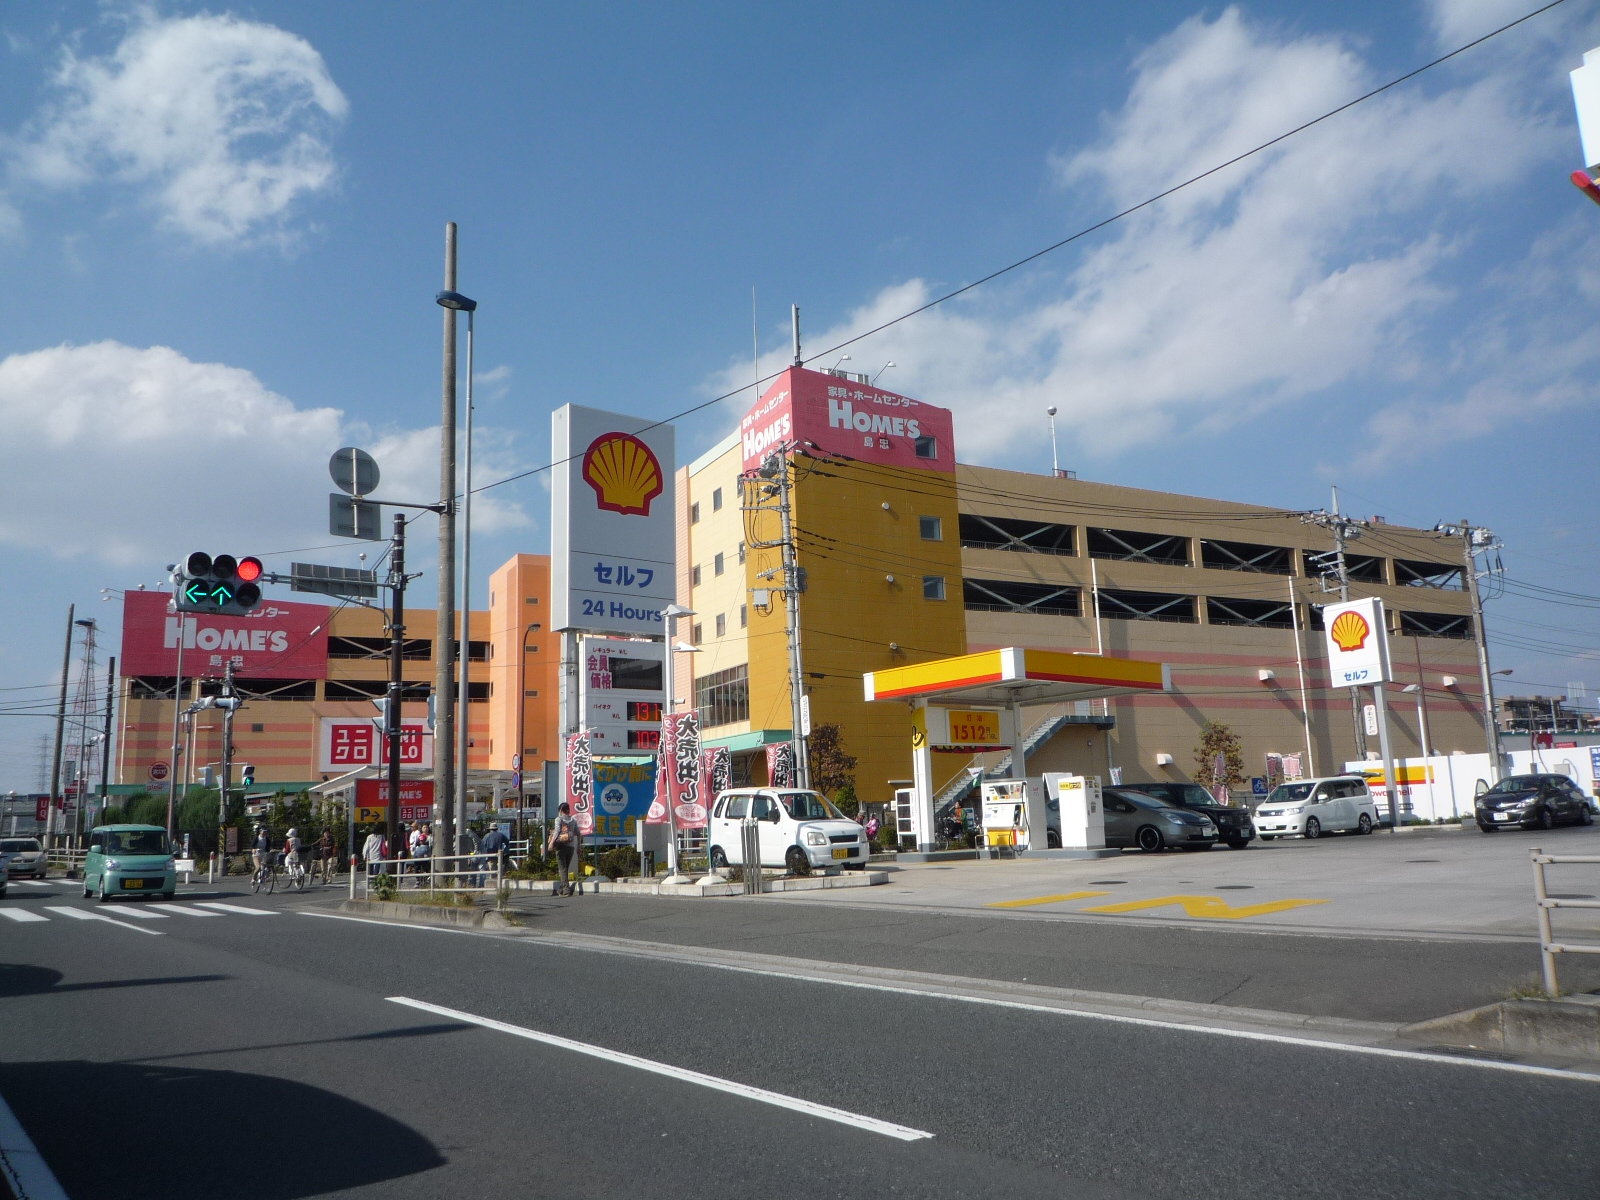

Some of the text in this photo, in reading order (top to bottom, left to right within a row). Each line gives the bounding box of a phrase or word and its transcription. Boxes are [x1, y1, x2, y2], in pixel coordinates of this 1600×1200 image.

[827, 386, 919, 407] 家具・ホームセンター
[828, 399, 921, 439] HOME'S
[743, 413, 790, 461] HOME'S
[593, 562, 654, 588] セルフ
[582, 599, 663, 622] 24 Hours
[164, 616, 289, 652] HOME'S
[588, 654, 608, 671] 会員
[591, 672, 612, 689] 価格
[1344, 670, 1368, 681] セルフ
[337, 729, 367, 742] ユニ
[953, 725, 985, 740] 1512
[335, 746, 367, 759] クロ
[676, 713, 699, 804] 大売出し
[573, 735, 589, 813] 大売出し
[379, 788, 422, 799] HME'S
[360, 808, 370, 821] P
